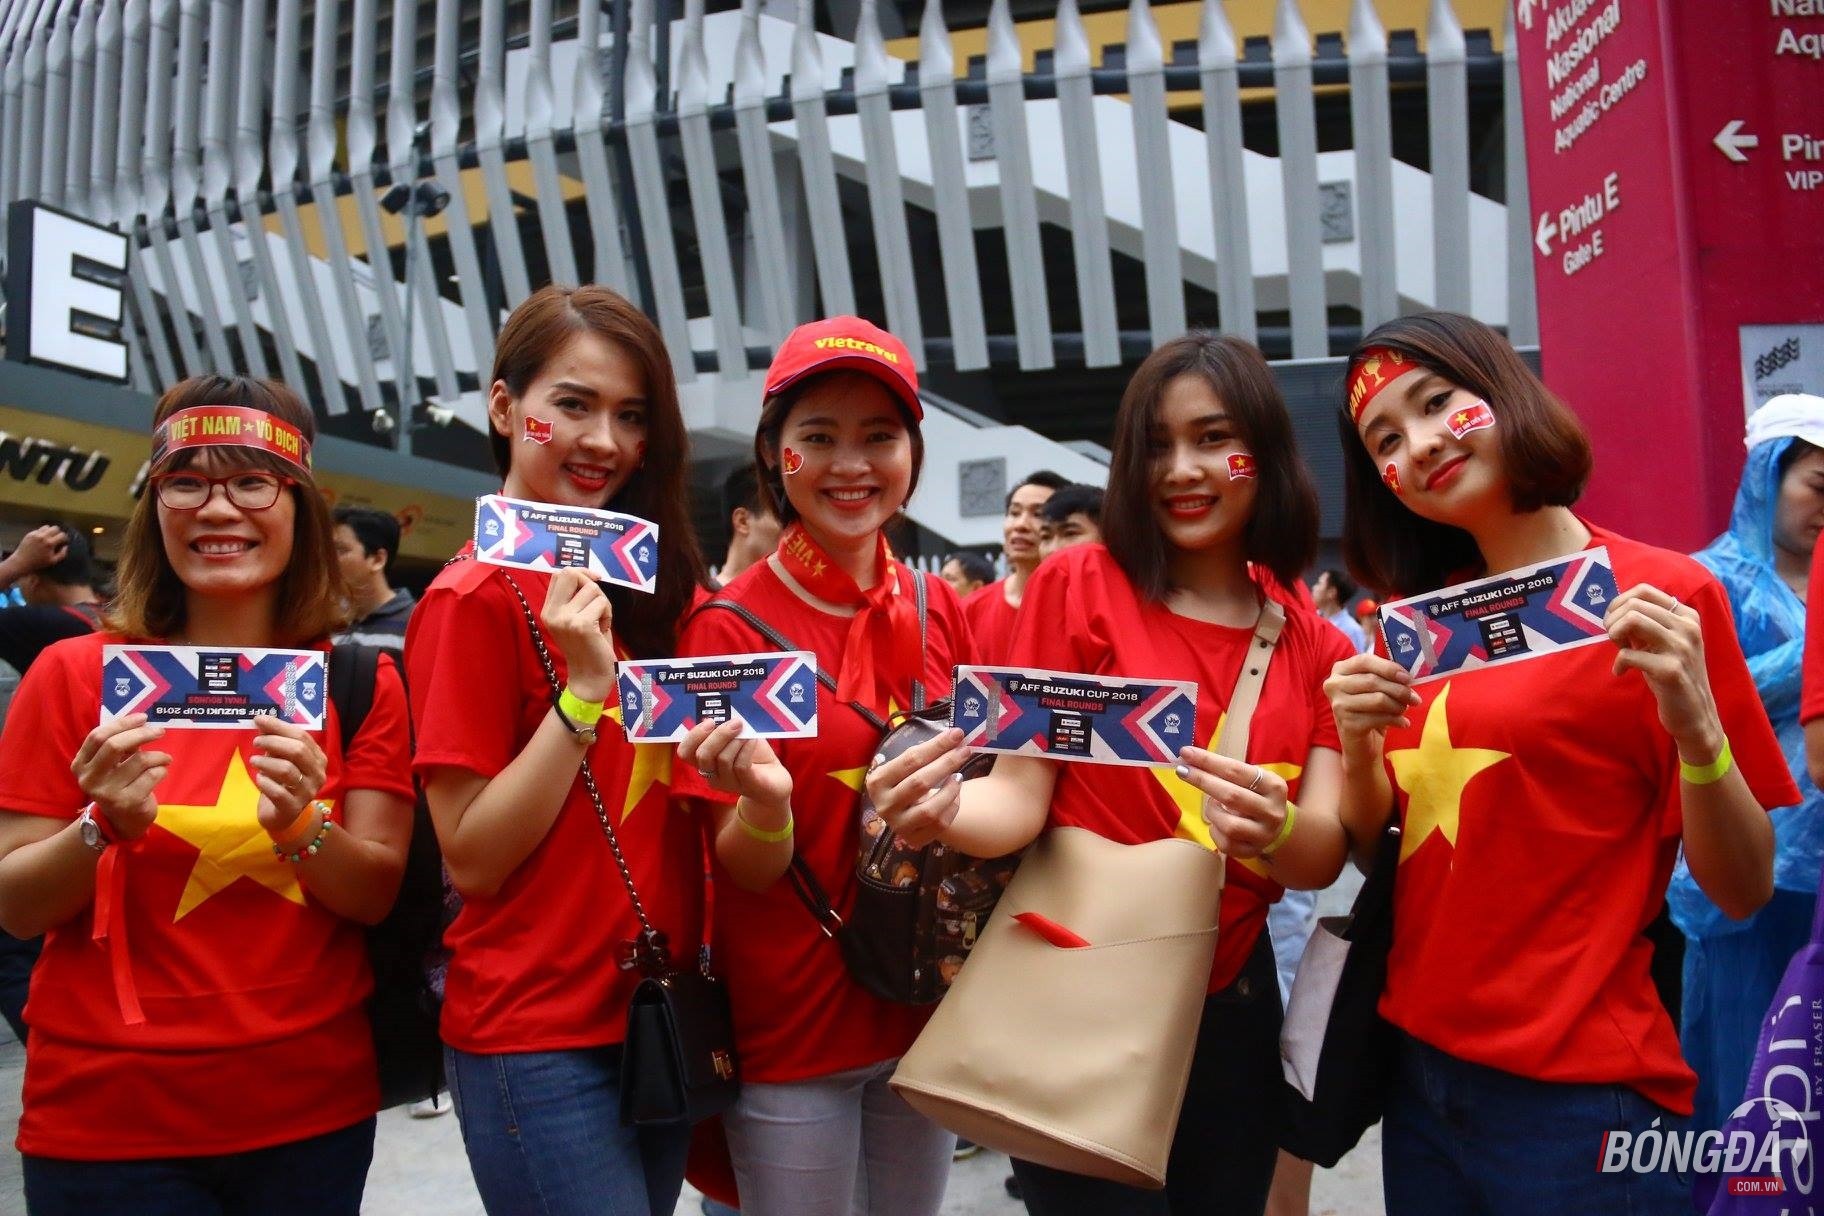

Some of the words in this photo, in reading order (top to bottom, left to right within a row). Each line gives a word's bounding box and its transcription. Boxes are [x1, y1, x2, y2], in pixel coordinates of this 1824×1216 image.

[1546, 0, 1595, 50] Akua
[1547, 0, 1620, 90] Nasional
[1775, 27, 1824, 60] Aq
[1551, 57, 1600, 121] National
[1600, 59, 1647, 111] Centre
[1785, 170, 1824, 190] VIP
[1559, 193, 1604, 243] Pintu
[1604, 171, 1620, 211] E
[1563, 243, 1592, 275] Gate
[1592, 229, 1604, 256] E
[30, 206, 129, 381] E
[170, 415, 198, 441] VIỆT
[202, 416, 241, 435] NAM
[275, 428, 299, 455] ĐỊCH
[530, 512, 547, 521] AFF
[548, 515, 584, 525] SUZUKI
[584, 519, 603, 527] CUP
[603, 522, 624, 531] 2018
[547, 524, 568, 533] FINAL
[569, 526, 598, 536] ROUNDS
[1441, 601, 1460, 612] AFF
[1461, 590, 1502, 606] SUZUKI
[1504, 583, 1526, 596] CUP
[1527, 576, 1554, 589] 2018
[1465, 605, 1488, 618] FINAL
[1489, 597, 1525, 612] ROUNDS
[668, 672, 686, 680] AFF
[687, 671, 721, 679] SUZUKI
[722, 669, 742, 678] CUP
[743, 667, 765, 676] 2018
[687, 682, 707, 691] FINAL
[708, 680, 737, 690] ROUNDS
[1020, 682, 1041, 692] AFF
[1042, 685, 1085, 697] SUZUKI
[1087, 689, 1110, 699] CUP
[1111, 691, 1138, 701] 2018
[188, 696, 223, 704] ROUNDS
[224, 696, 247, 704] FINAL
[1041, 698, 1066, 708] FINAL
[1066, 700, 1104, 711] ROUNDS
[183, 707, 205, 715] CUP
[206, 707, 247, 715] SUZUKI
[249, 707, 267, 716] AFF
[1811, 998, 1823, 1067] FRASER
[1815, 1077, 1824, 1096] BY
